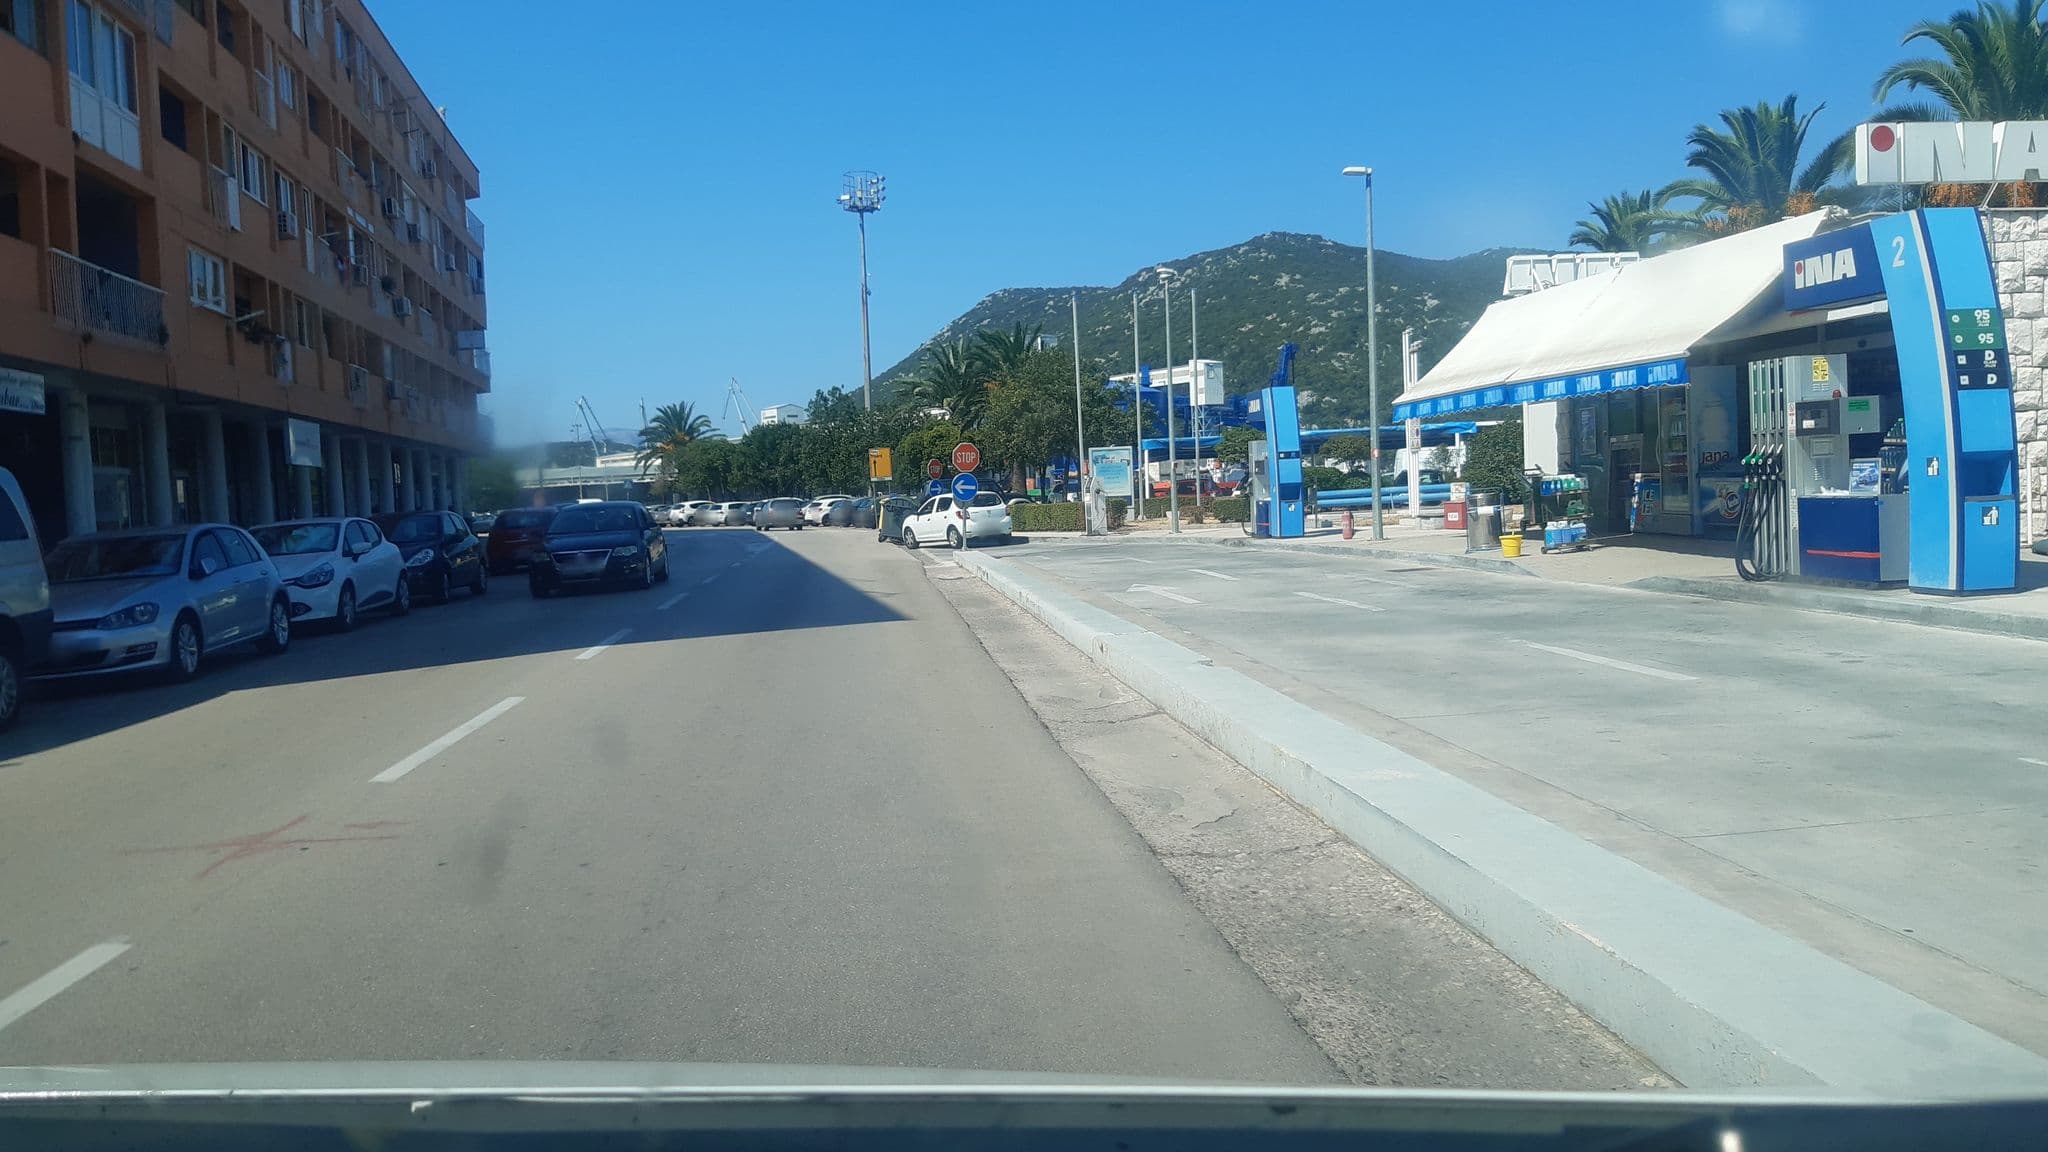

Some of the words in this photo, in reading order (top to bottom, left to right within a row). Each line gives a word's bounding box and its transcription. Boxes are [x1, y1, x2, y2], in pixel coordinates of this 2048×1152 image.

[1892, 236, 1905, 268] 2
[1795, 248, 1856, 289] INA
[1974, 309, 1990, 320] 95
[1978, 333, 1994, 344] 95
[1984, 350, 1994, 360] D
[1987, 374, 1997, 384] D
[956, 452, 976, 464] STOP
